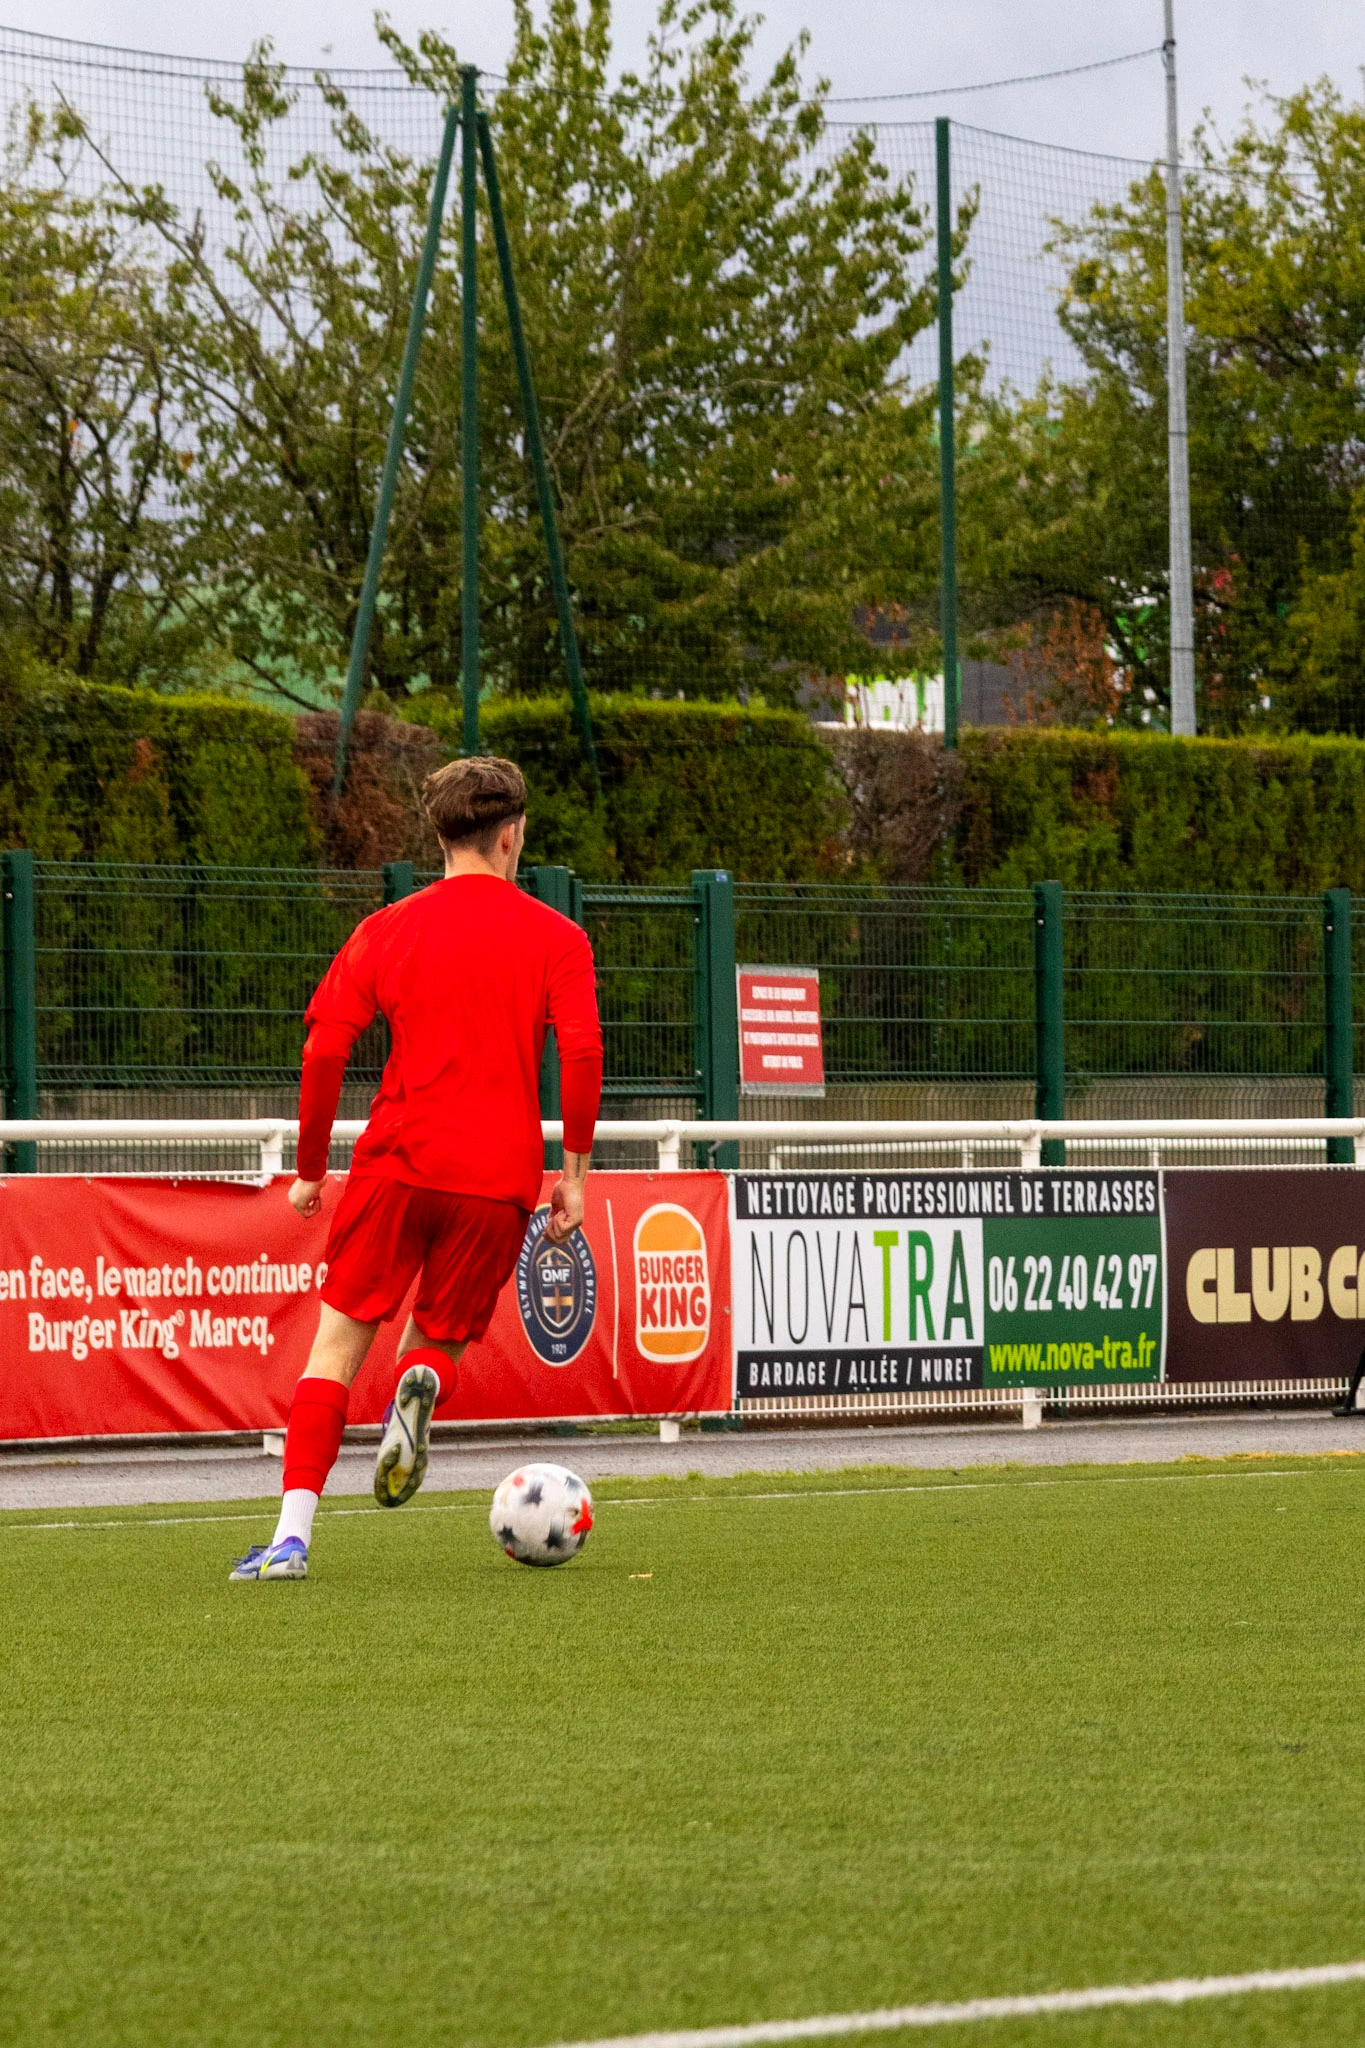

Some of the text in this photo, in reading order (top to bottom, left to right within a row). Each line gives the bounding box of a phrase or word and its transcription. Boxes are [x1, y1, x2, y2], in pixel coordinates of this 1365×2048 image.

[747, 1180, 1155, 1215] NETTOYAGE PROFESSIONNEL DE TERRASSES
[29, 1254, 92, 1304] face,
[96, 1256, 121, 1296] le
[123, 1256, 201, 1296] match
[206, 1252, 312, 1295] continue
[542, 1268, 571, 1283] OMF
[639, 1255, 704, 1285] BURGER
[751, 1229, 974, 1344] NOVATRA
[988, 1254, 1157, 1312] 06 22 40 42 97
[640, 1286, 707, 1328] KING
[28, 1311, 116, 1361] Burger
[189, 1308, 274, 1356] Marcq.
[551, 1343, 567, 1355] 1921
[989, 1332, 1156, 1373] www.nova-tra.fr
[749, 1361, 826, 1387] BARDAGE
[848, 1355, 898, 1385] ALLÉE
[921, 1357, 973, 1382] MURET
